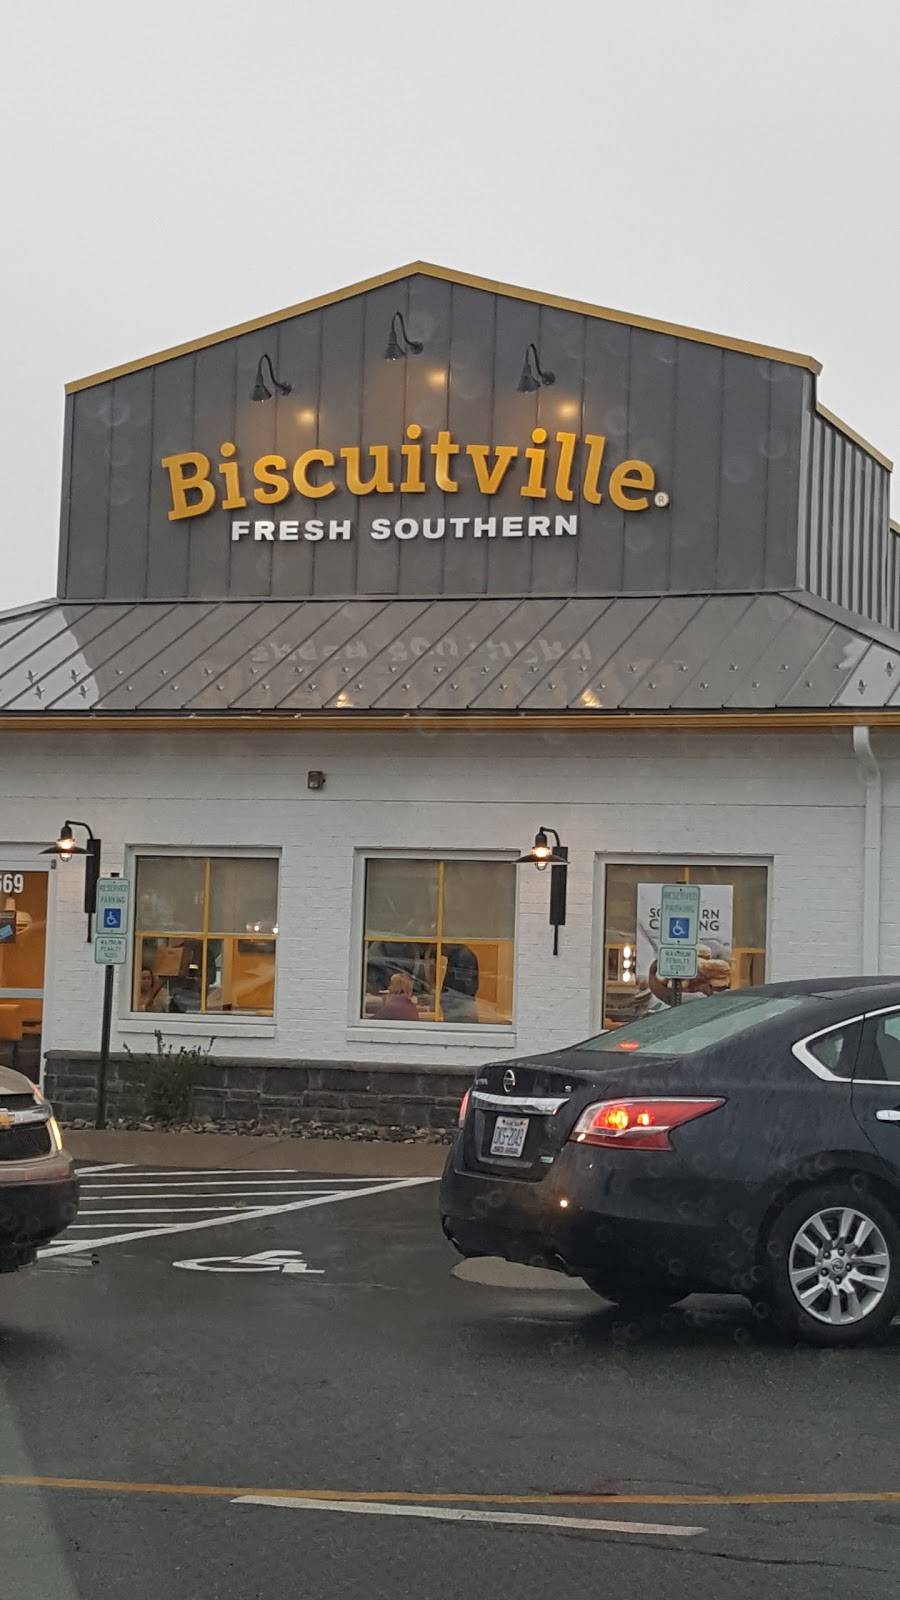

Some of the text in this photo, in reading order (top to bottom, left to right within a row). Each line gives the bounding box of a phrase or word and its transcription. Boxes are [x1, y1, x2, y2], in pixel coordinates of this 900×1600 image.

[231, 514, 579, 542] FRESH SOUTHERN
[0, 873, 24, 894] 69
